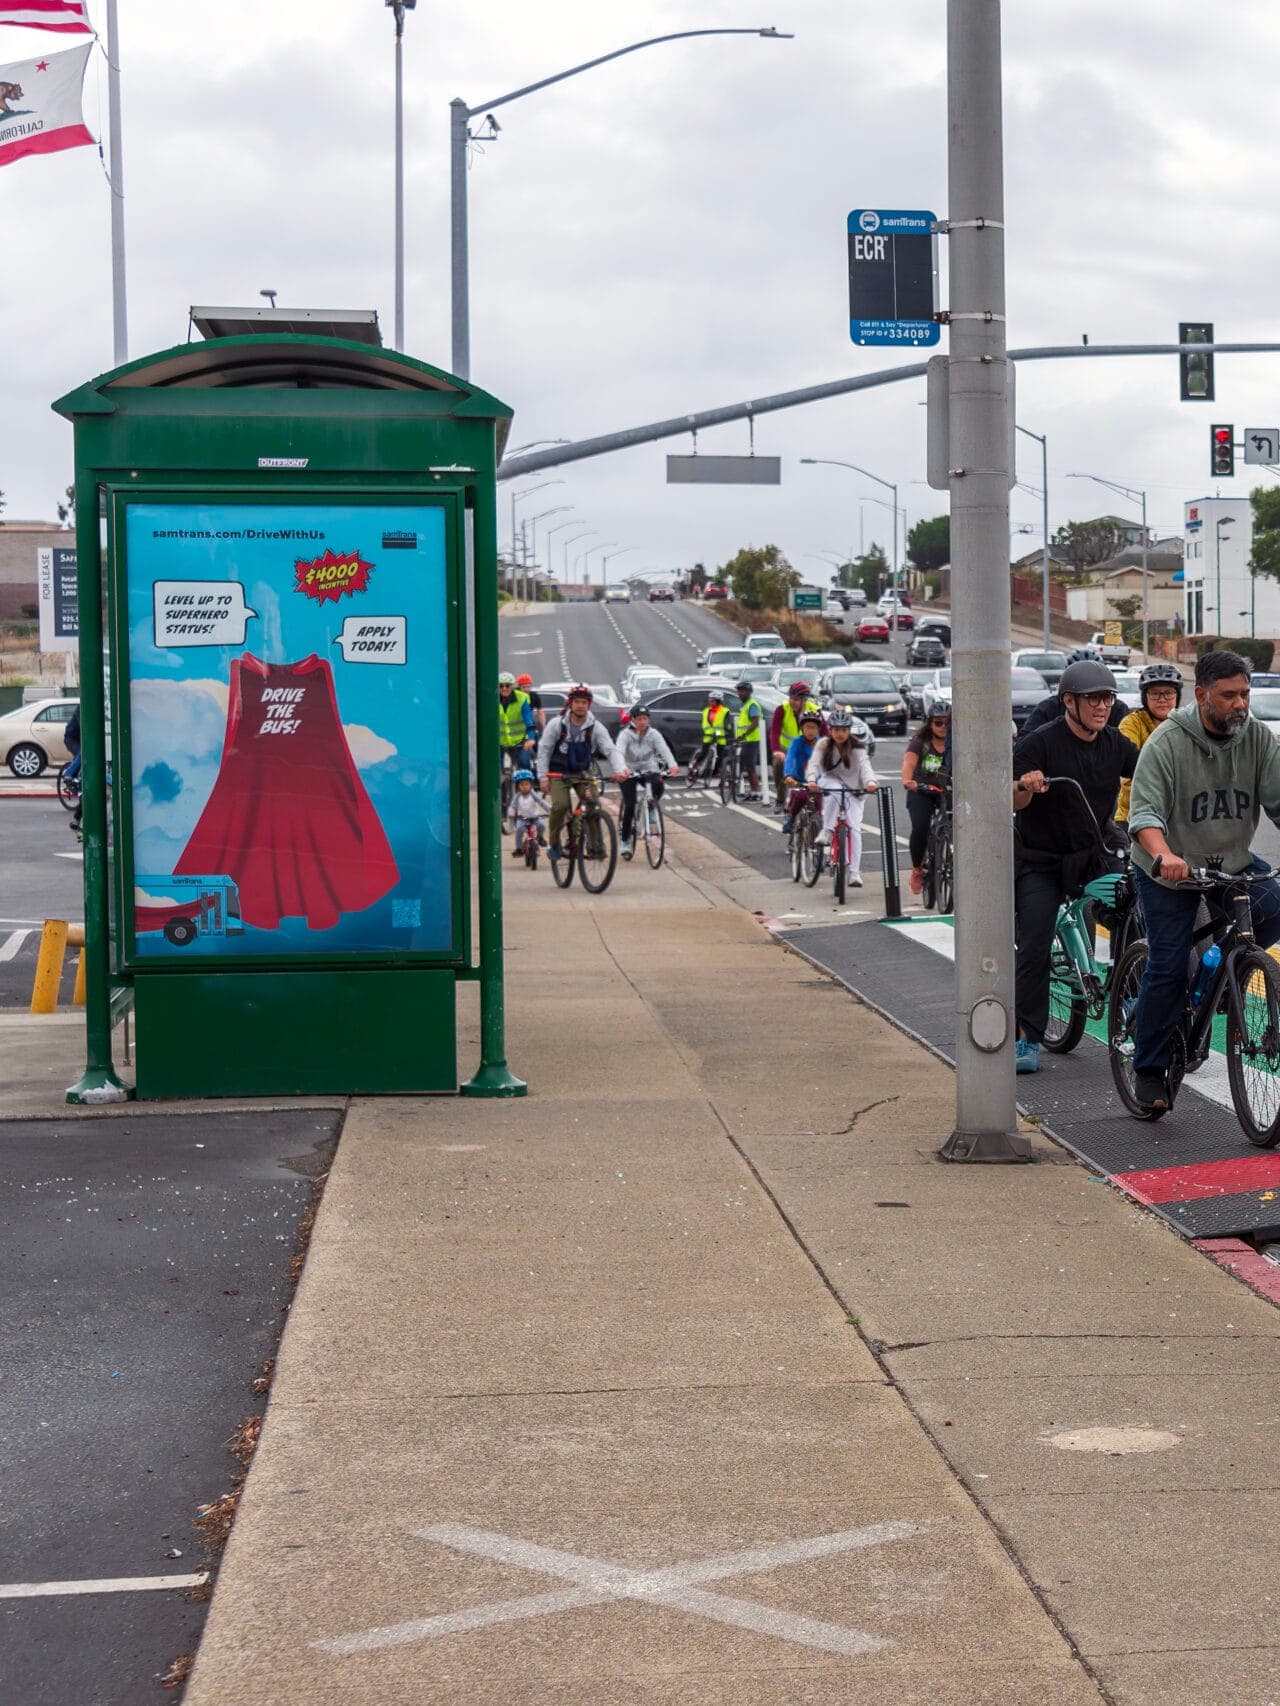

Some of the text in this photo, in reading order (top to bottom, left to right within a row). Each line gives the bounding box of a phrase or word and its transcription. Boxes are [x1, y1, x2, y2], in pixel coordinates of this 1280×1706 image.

[882, 218, 926, 227] samTrans
[889, 329, 930, 339] 334089
[153, 529, 326, 540] samtrans.com/DriveWithUs
[41, 553, 50, 599] FOR LEASE
[305, 562, 359, 585] $4000
[318, 579, 350, 591] INCENTIVE
[164, 595, 232, 605] LEVEL UP TO
[166, 610, 229, 620] SUPERHERO
[166, 624, 216, 634] STATUS!
[357, 626, 395, 637] APPLY
[350, 640, 398, 652] TODAY!
[261, 687, 306, 702] DRIVE
[266, 703, 296, 718] THE
[260, 719, 302, 734] BUS!
[1190, 789, 1250, 823] GAP
